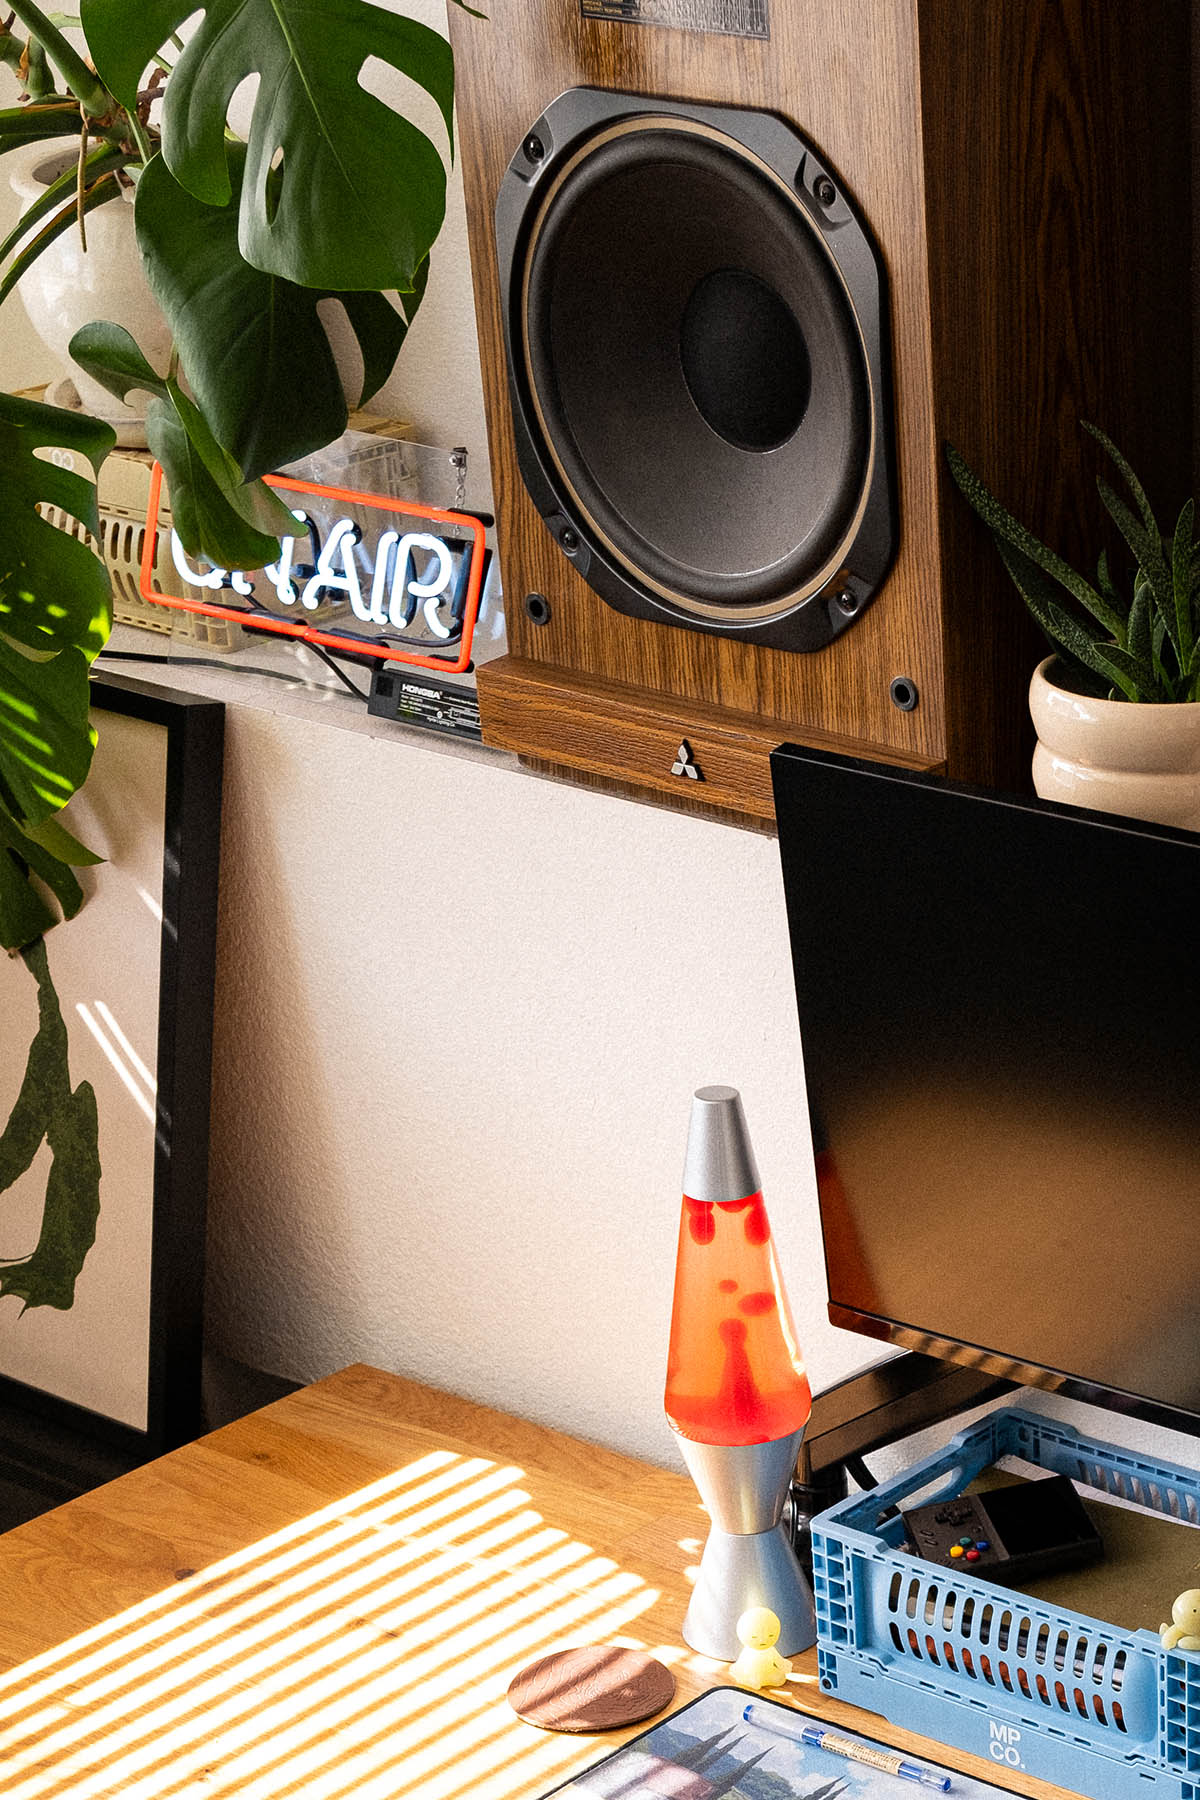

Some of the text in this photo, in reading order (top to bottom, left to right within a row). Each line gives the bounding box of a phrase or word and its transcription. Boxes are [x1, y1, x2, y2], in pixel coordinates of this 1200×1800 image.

[301, 518, 454, 639] AIR
[989, 1720, 1021, 1745] MP
[989, 1741, 1026, 1769] CO.
